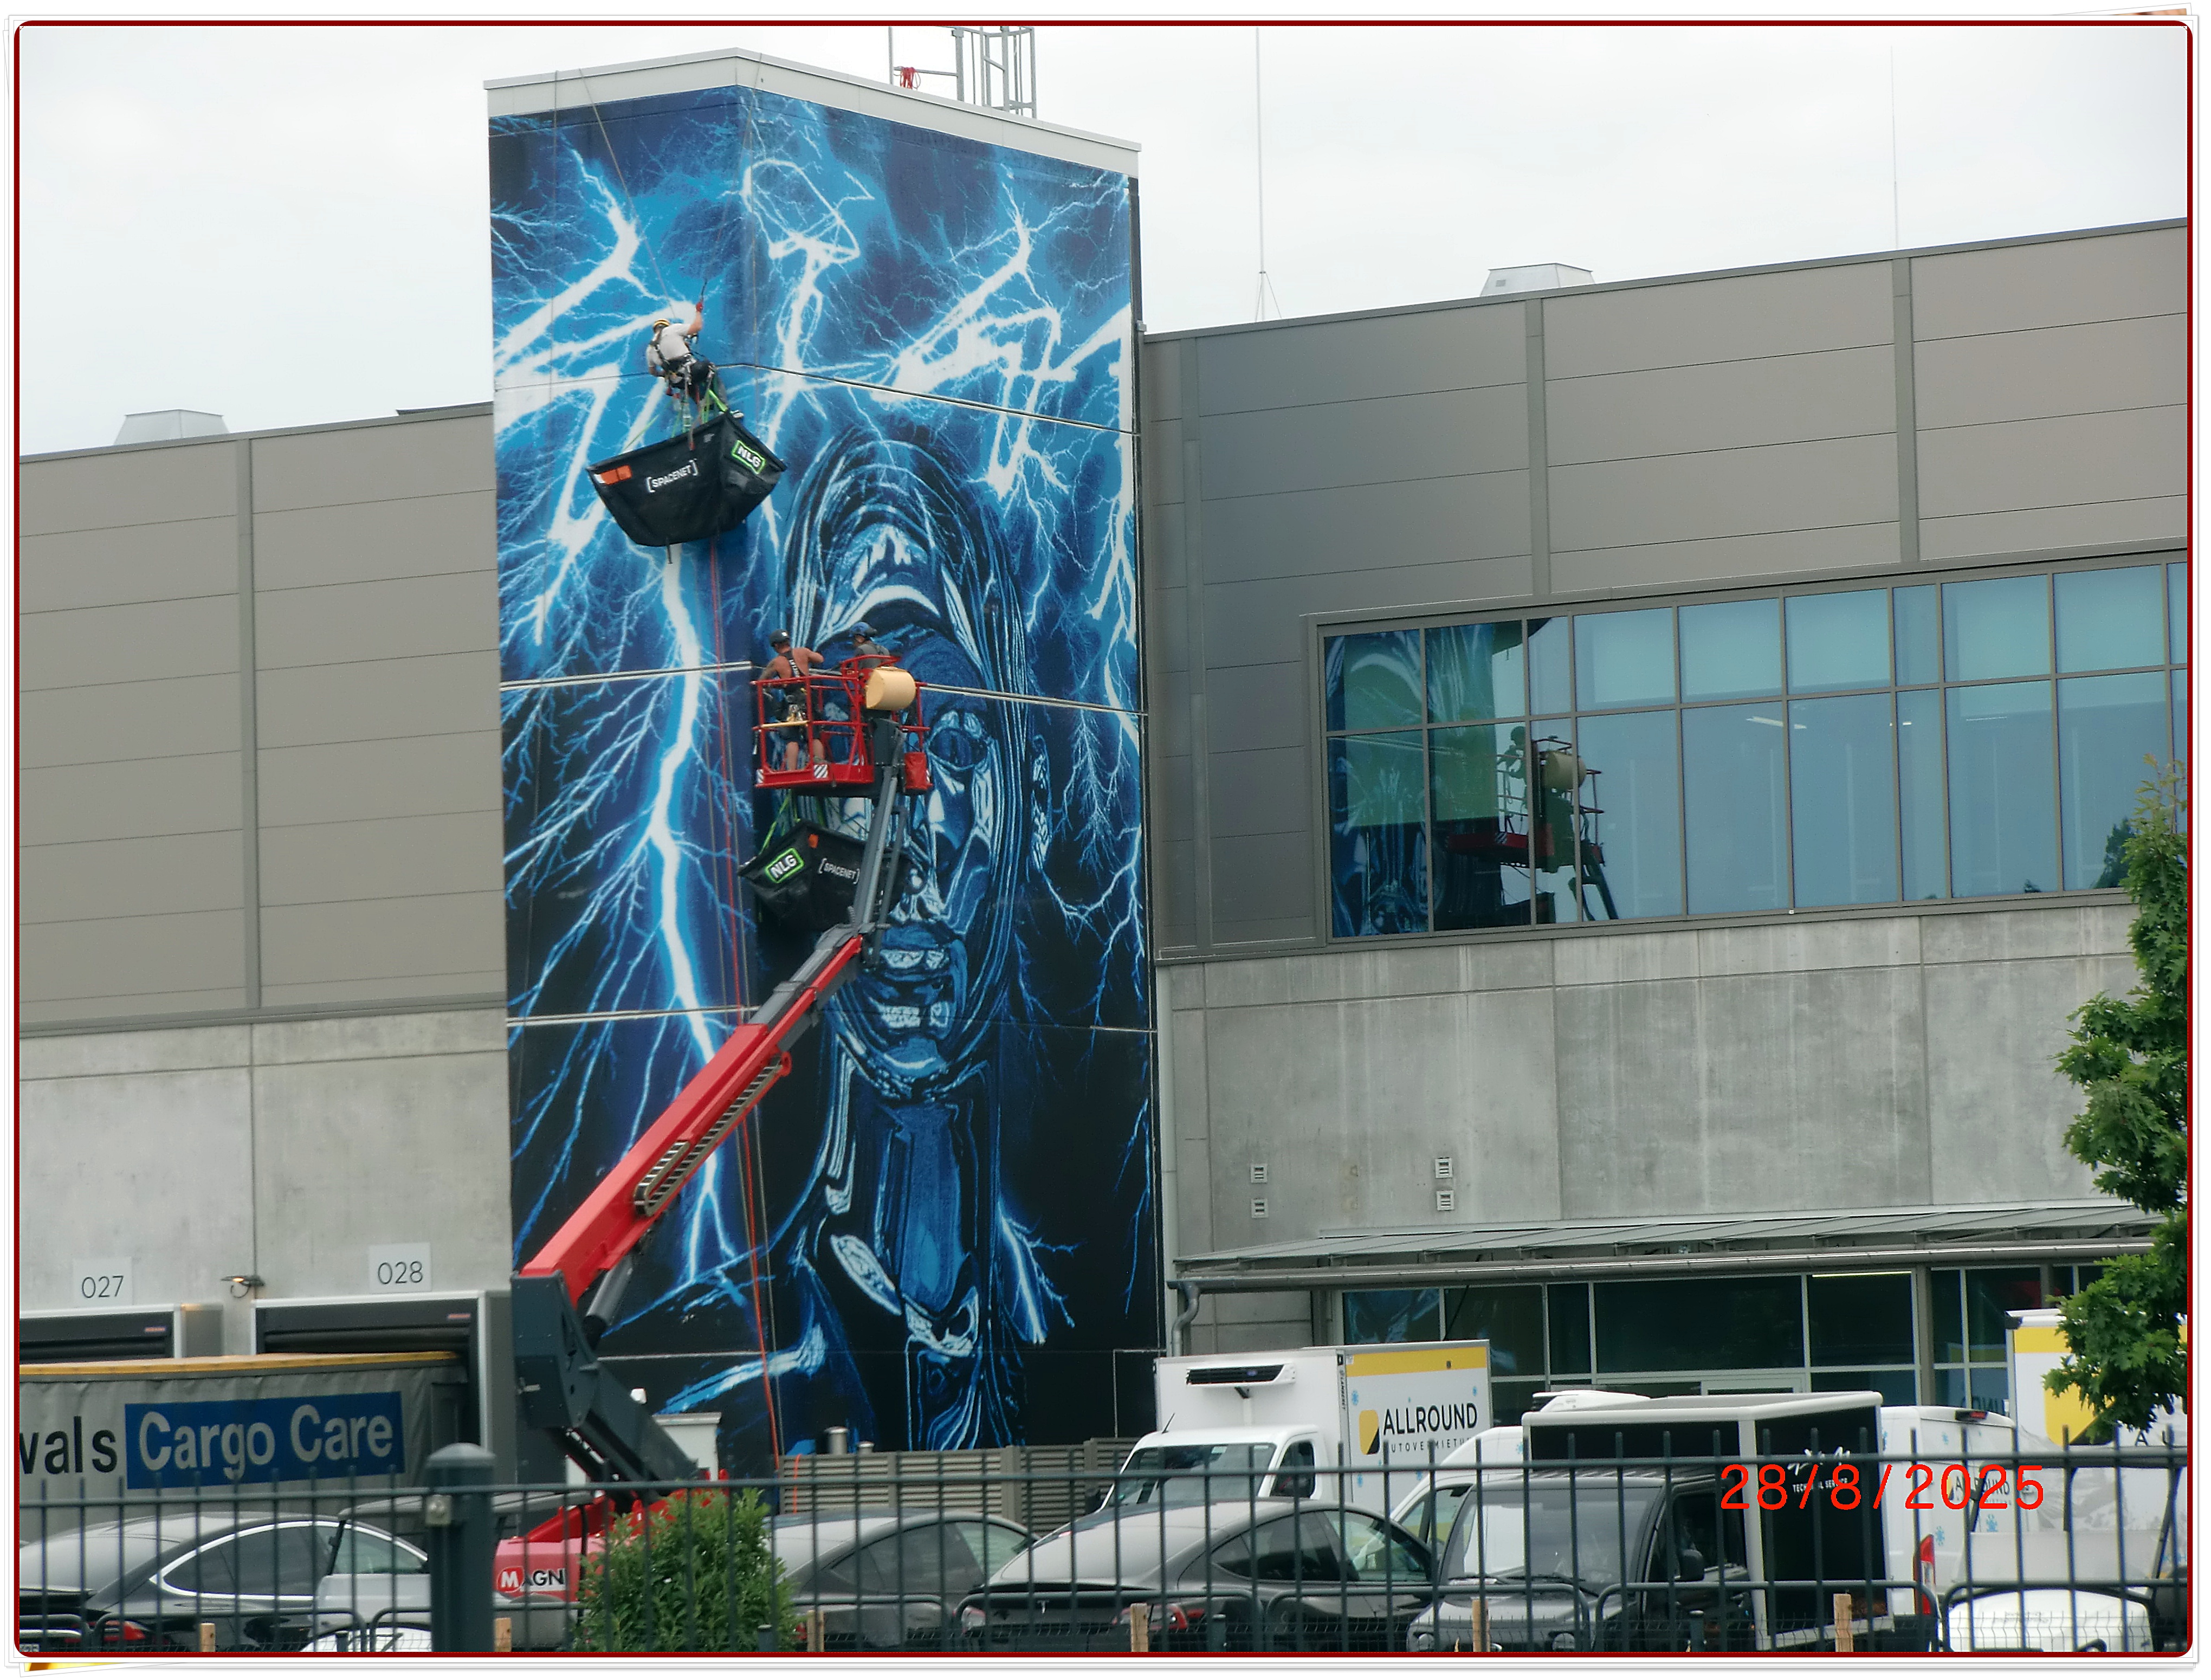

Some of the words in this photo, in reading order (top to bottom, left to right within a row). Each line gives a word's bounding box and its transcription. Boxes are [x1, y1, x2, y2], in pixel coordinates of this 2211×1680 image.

[738, 446, 761, 467] NLG
[770, 855, 797, 878] NLG
[378, 1261, 423, 1284] 028
[81, 1275, 124, 1298] 027
[1384, 1403, 1478, 1436] ALLROUND
[140, 1412, 275, 1480] Cargo
[290, 1405, 392, 1462] Care
[501, 1568, 566, 1588] MAGN
